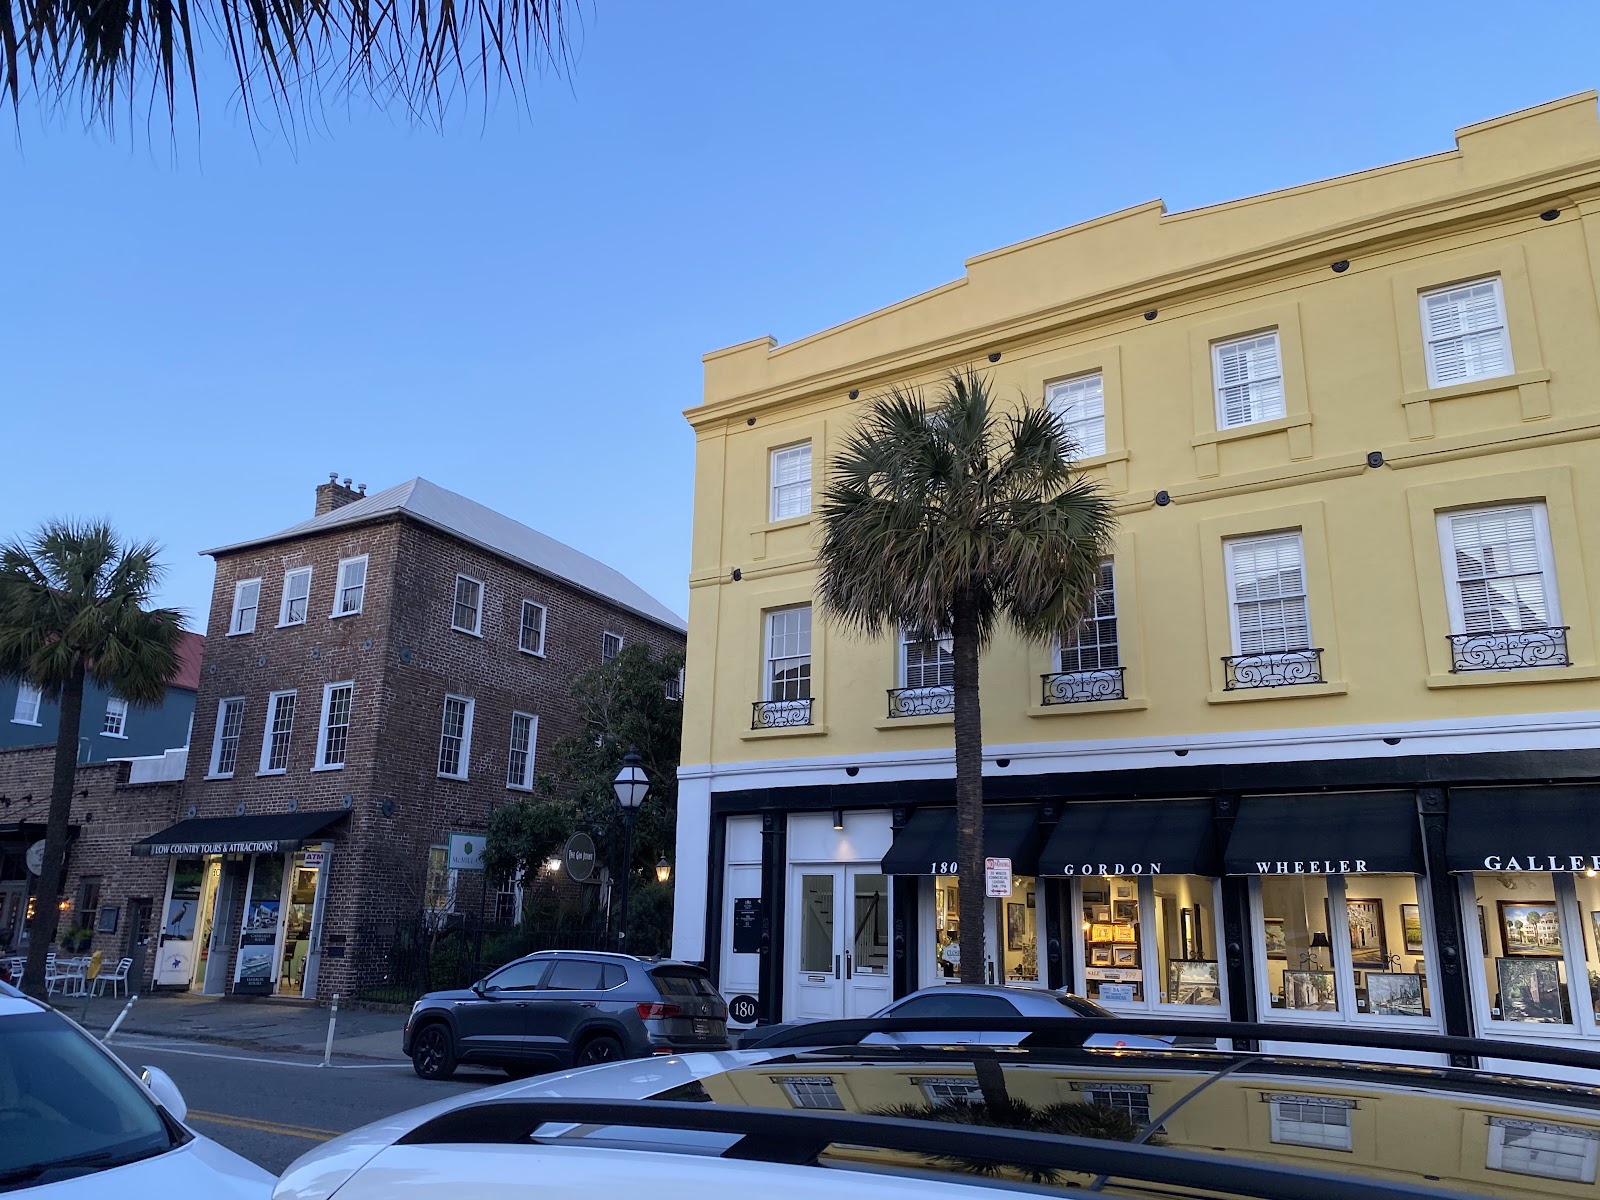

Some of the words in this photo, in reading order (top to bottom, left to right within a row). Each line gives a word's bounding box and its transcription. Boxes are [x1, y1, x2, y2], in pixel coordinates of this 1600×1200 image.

[155, 845, 169, 854] LOW
[170, 845, 199, 854] COUNTRY
[201, 843, 222, 854] TOURS
[223, 844, 228, 853] &
[229, 841, 273, 852] ATTRACTIONS
[930, 861, 958, 874] 180
[987, 859, 994, 869] NO
[1063, 862, 1162, 875] GORDON
[1255, 860, 1368, 874] WHEELER
[734, 1001, 755, 1018] 180
